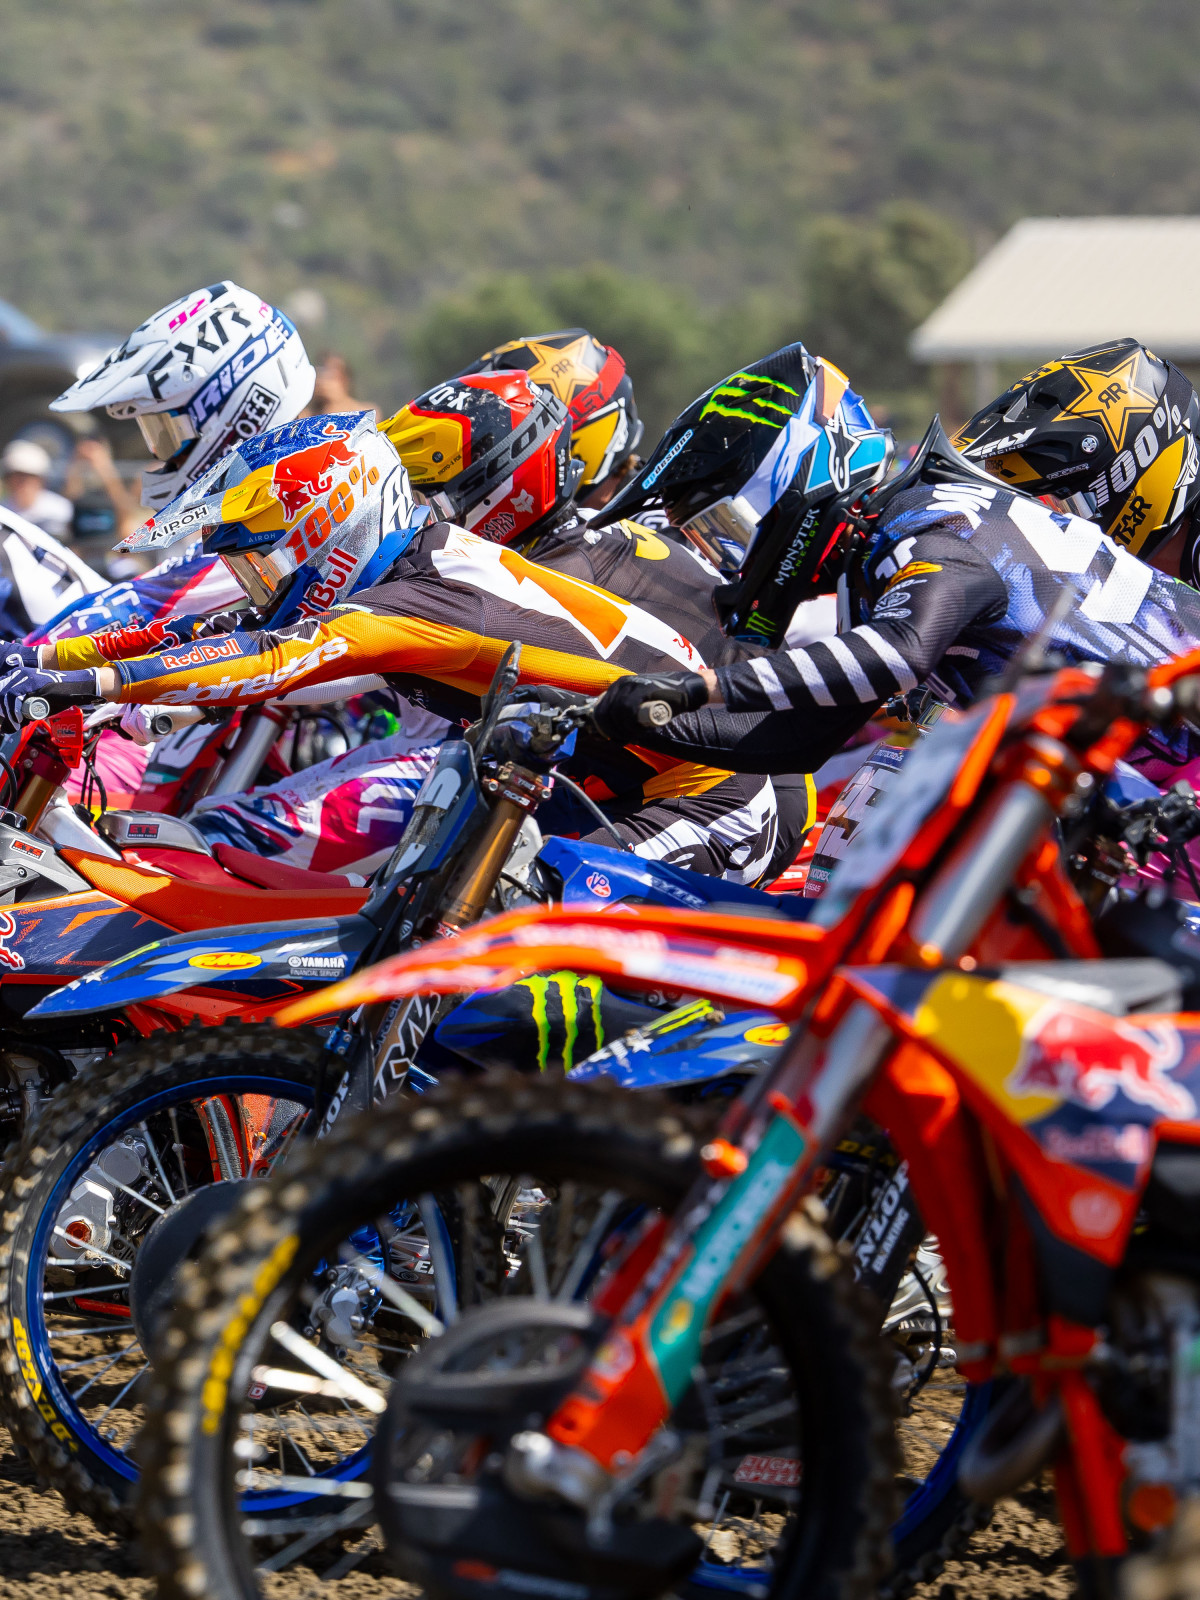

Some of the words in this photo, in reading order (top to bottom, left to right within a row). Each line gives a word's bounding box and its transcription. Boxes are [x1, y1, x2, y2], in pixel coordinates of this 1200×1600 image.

[147, 301, 251, 403] FXR
[1088, 393, 1182, 508] 100%
[285, 453, 381, 565] 100%
[150, 506, 208, 542] AIROH
[248, 532, 276, 543] AIROH
[160, 649, 205, 670] Red
[202, 638, 243, 661] Bull
[130, 824, 158, 834] ETS
[13, 840, 43, 855] ETS
[290, 968, 318, 977] FINANCIAL
[301, 956, 346, 968] YAMAHA
